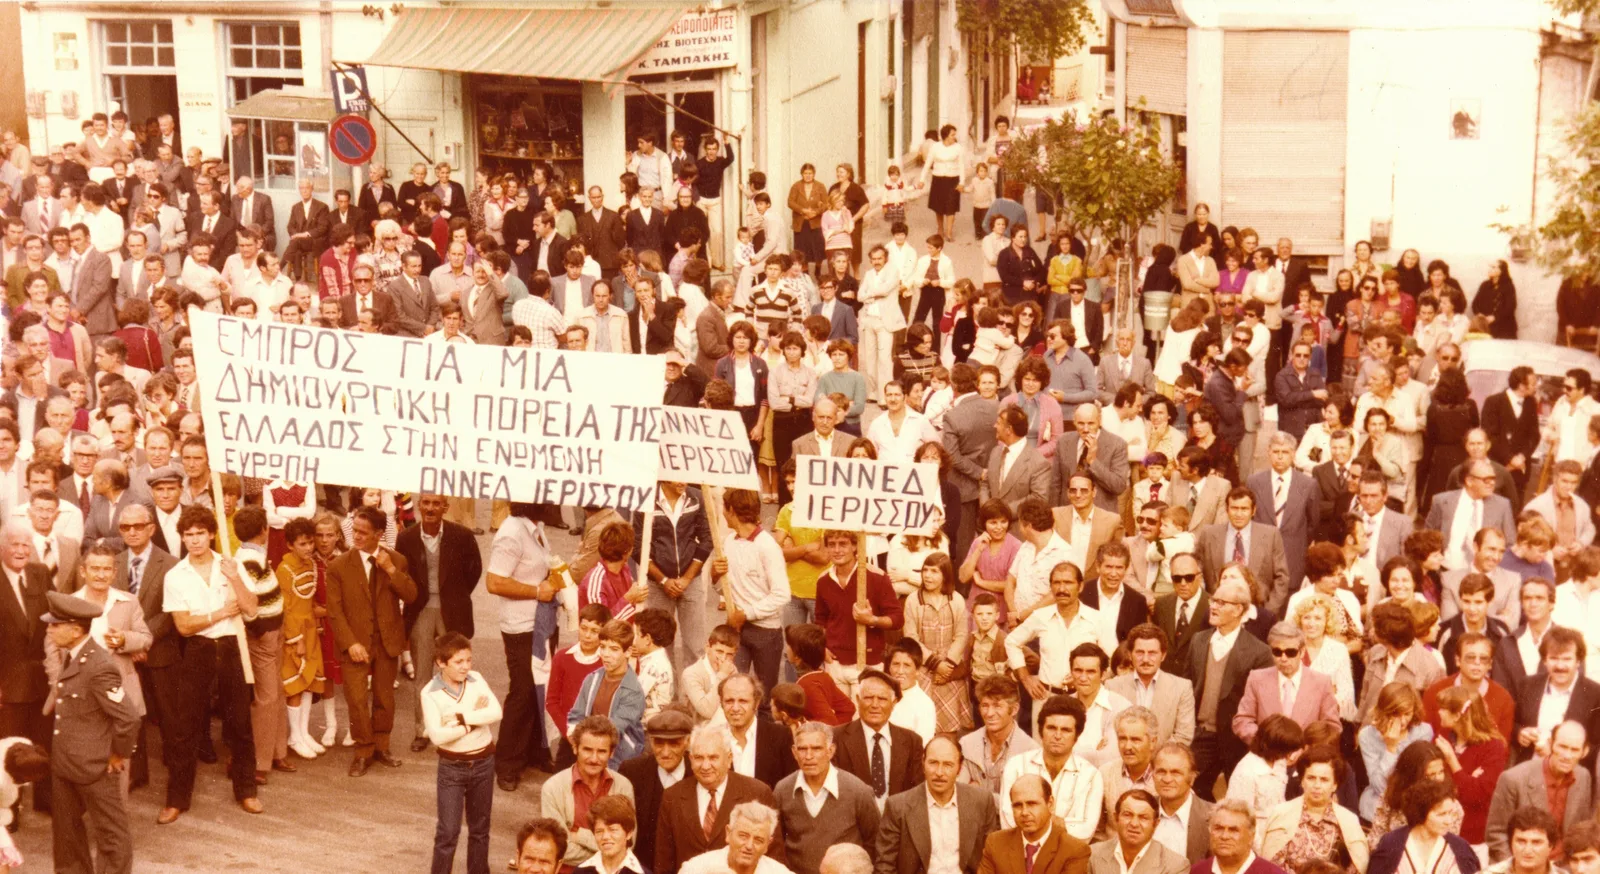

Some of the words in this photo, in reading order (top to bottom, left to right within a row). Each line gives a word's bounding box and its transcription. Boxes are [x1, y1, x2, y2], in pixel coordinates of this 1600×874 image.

[653, 52, 730, 68] ΤΑΜΠΑΚΗΣ
[675, 34, 733, 48] ΒΙΟΤΕΧΝΙΑΣ
[335, 71, 362, 110] P
[218, 318, 364, 374] ΕΜΠΡΟΣ
[400, 340, 462, 384] ΓΙΑ
[500, 348, 572, 393] ΜΙΑ
[215, 363, 450, 425] ΔΗΜΙΟΥΡΓΙΚΗ
[473, 394, 601, 442] ΠΟΡΕΙΑ
[611, 404, 662, 443] ΤΗΣ
[218, 411, 364, 452] ΕΛΛΑΔΟΣ
[382, 425, 458, 461] ΣΤΗΝ
[477, 437, 603, 475] ΕΝΩΜΕΝΗ
[225, 448, 319, 481] ΕΥΡΩΠΗ
[420, 466, 511, 500] ΟΝΝΕΔ
[533, 478, 653, 511] ΙΕΡΙΣΣΟΥ
[809, 459, 924, 496] ΟΝΝΕΔ
[808, 494, 934, 531] ΙΕΡΙΣΣΟΥ
